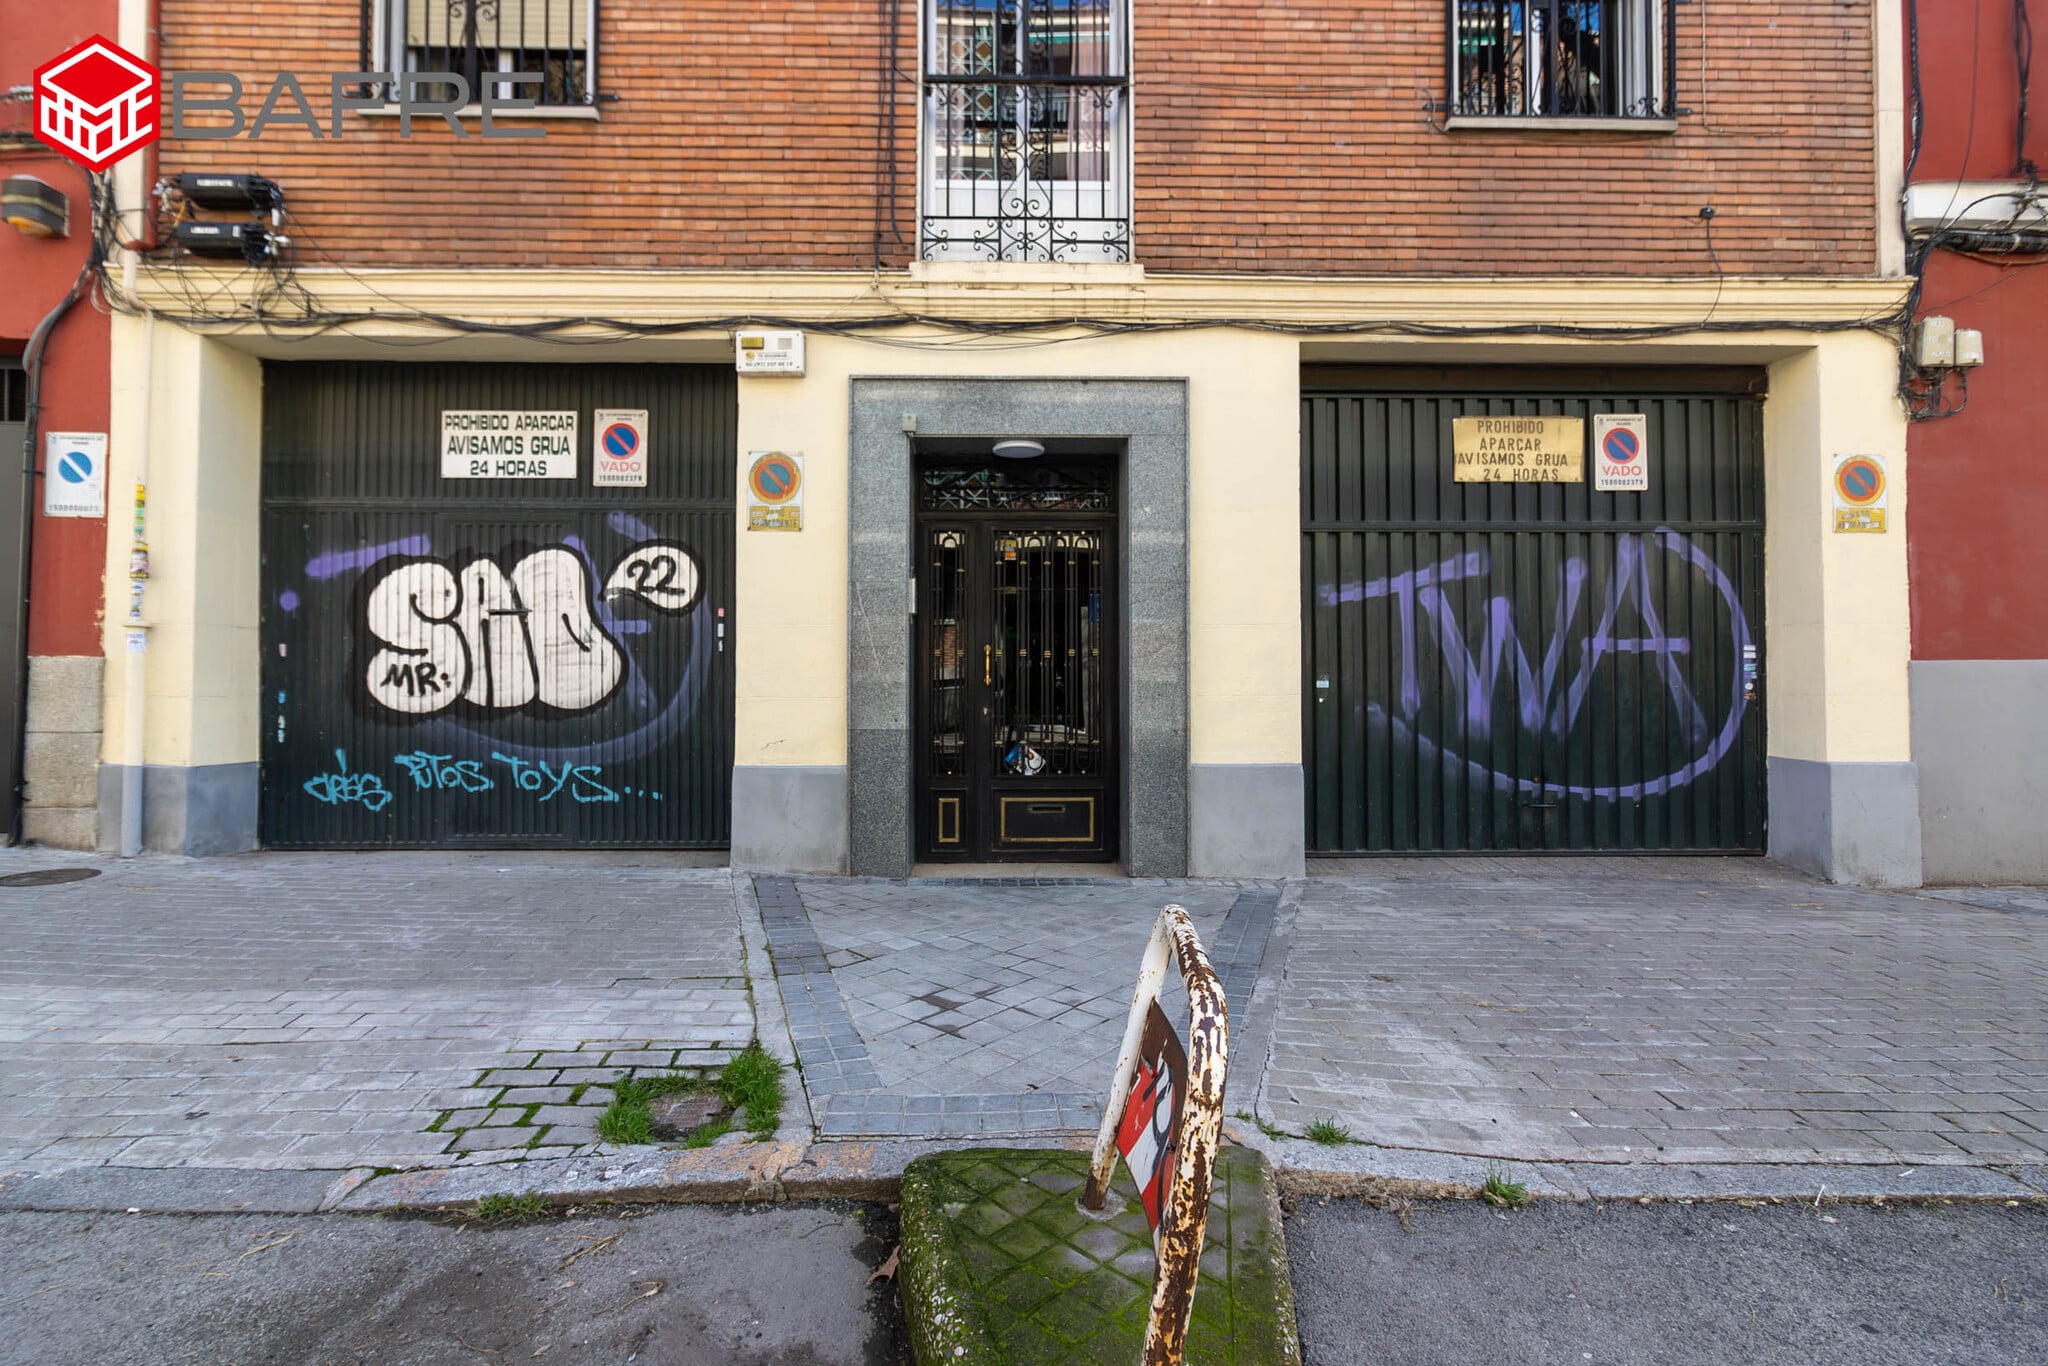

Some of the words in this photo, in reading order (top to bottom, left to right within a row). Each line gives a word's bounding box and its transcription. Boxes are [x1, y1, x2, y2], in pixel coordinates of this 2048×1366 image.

[445, 415, 509, 430] PROHIBIDO
[515, 415, 574, 431] APARCAR
[1477, 420, 1544, 434] PROHIBIDO
[447, 436, 524, 455] AVISAMOS
[530, 436, 570, 455] GRUA
[1479, 437, 1542, 451] APARCAR
[1457, 453, 1525, 466] AVISAMOS
[1535, 453, 1568, 466] GRUA
[470, 460, 489, 476] 24
[495, 460, 547, 476] HORAS
[599, 461, 641, 473] VADO
[1602, 465, 1642, 477] VADO
[1483, 468, 1501, 481] 24
[1513, 468, 1559, 481] HORAS
[627, 554, 687, 596] 22
